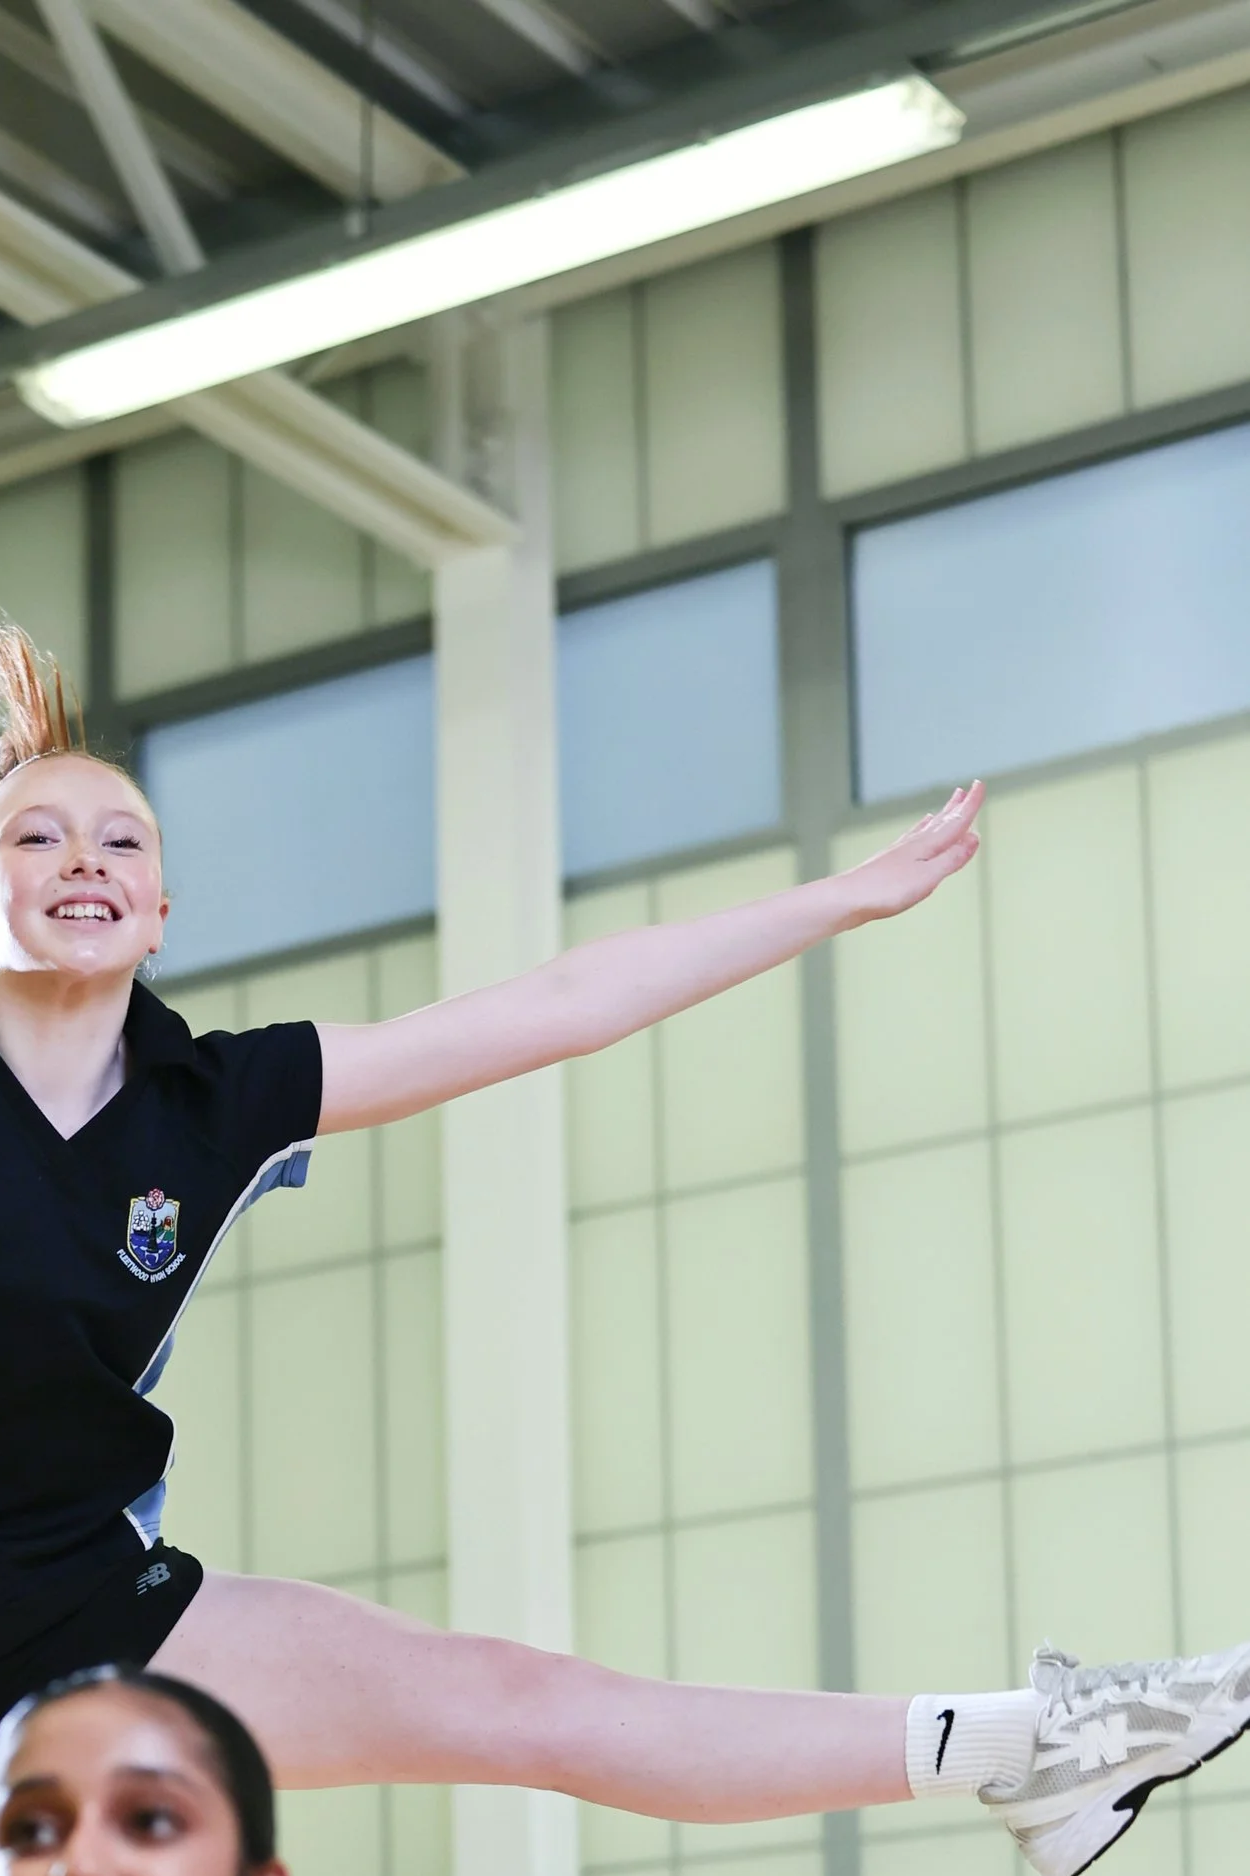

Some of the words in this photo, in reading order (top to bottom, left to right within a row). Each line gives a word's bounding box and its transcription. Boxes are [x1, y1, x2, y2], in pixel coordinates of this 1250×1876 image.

[116, 1248, 149, 1282] FLEETWOOD
[150, 1271, 167, 1283] HIGH
[165, 1252, 186, 1275] SCHOOL
